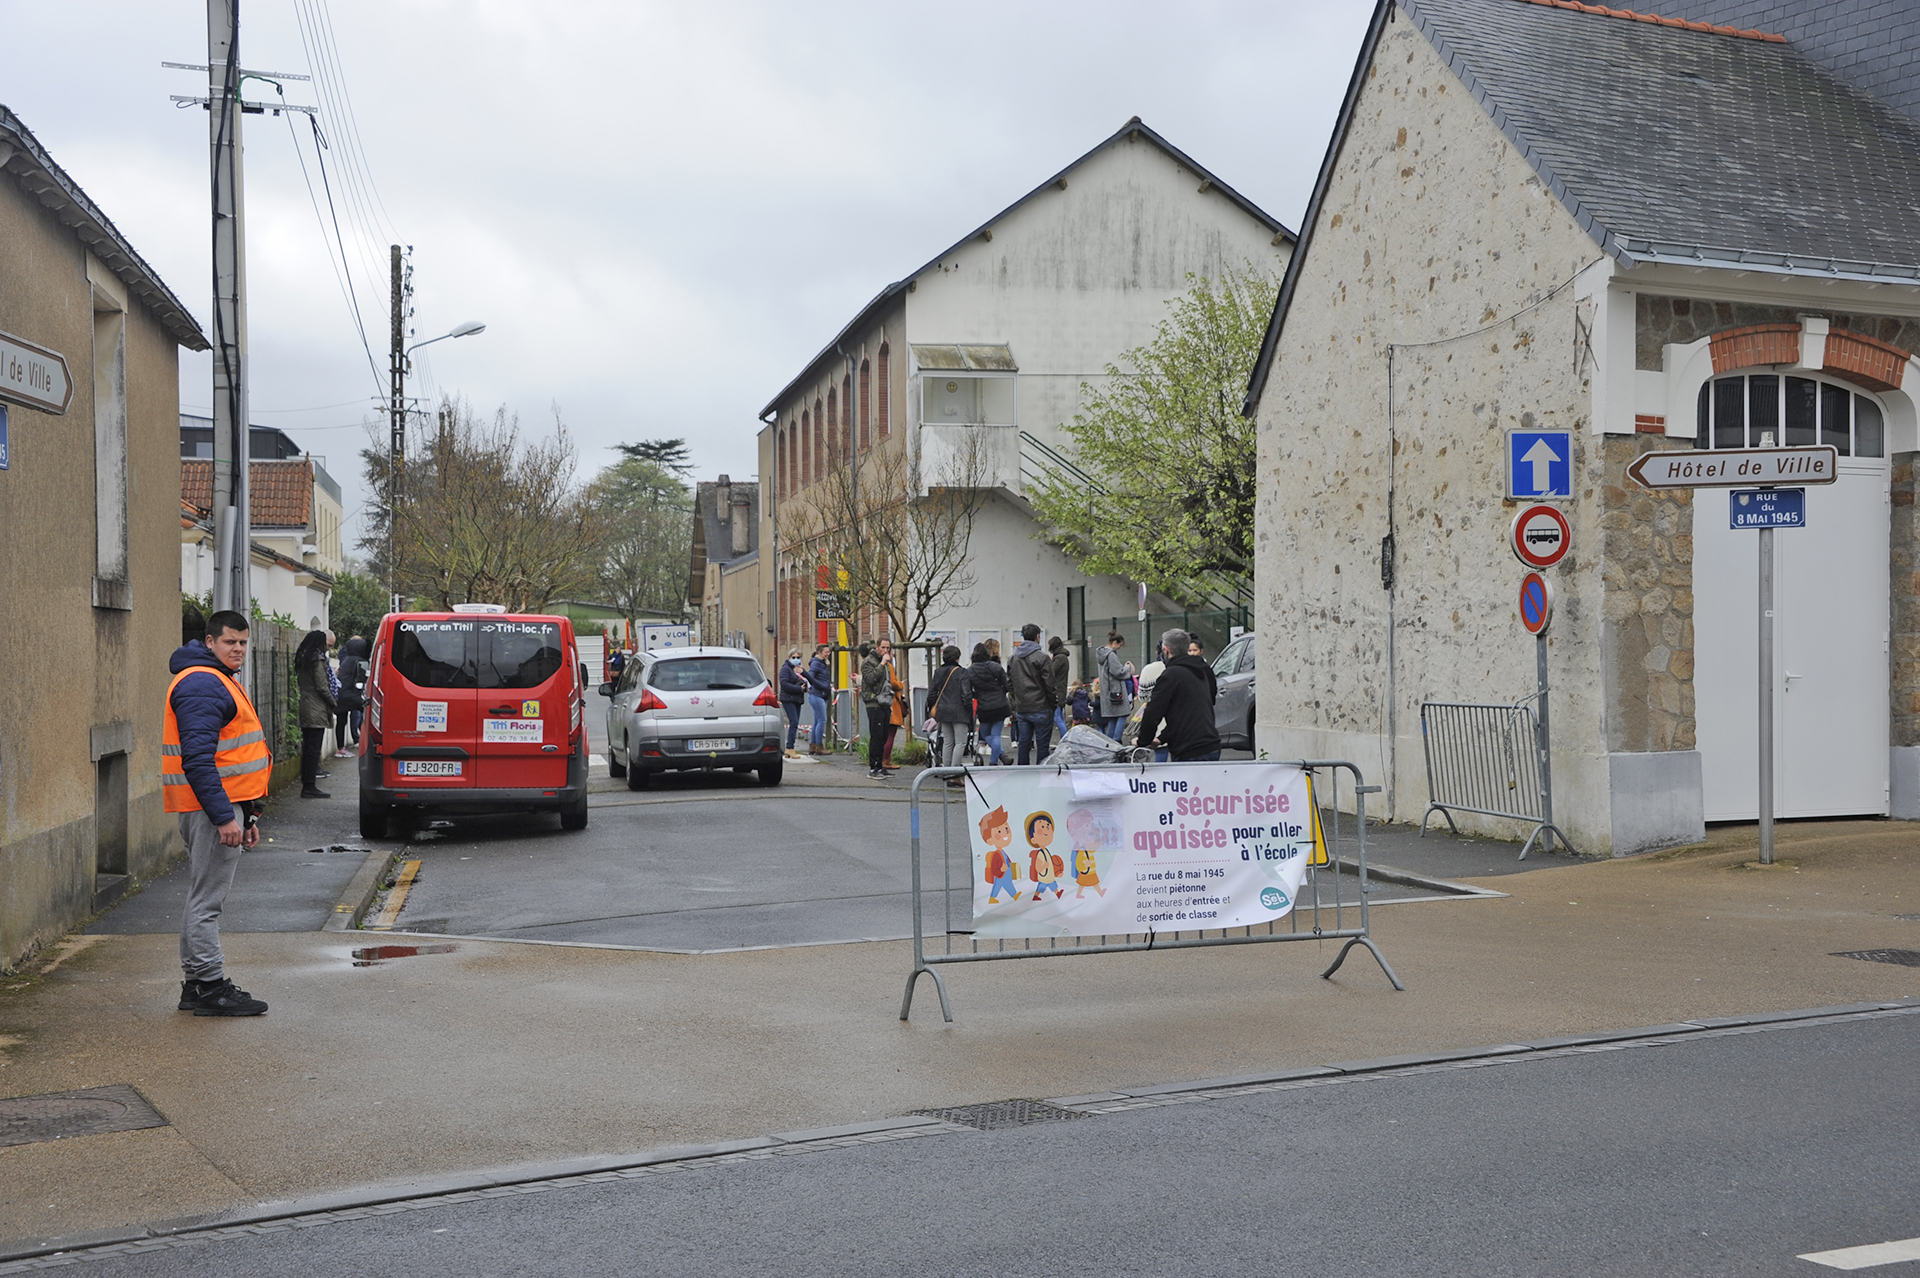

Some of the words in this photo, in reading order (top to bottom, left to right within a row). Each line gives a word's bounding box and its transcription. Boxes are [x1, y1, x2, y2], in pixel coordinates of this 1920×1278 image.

[10, 355, 22, 382] de
[28, 360, 51, 392] Ville
[1668, 460, 1726, 478] Hôtel
[1738, 459, 1762, 476] de
[1776, 456, 1824, 474] Ville
[1737, 514, 1744, 525] 8
[1771, 512, 1798, 524] 1945
[400, 623, 414, 632] On
[416, 623, 438, 633] part
[452, 622, 473, 632] Titi!
[495, 623, 553, 634] Titi-loc.fr
[491, 721, 507, 729] Titi
[510, 721, 536, 730] Floris
[406, 763, 454, 772] EJ-920-FR
[1129, 778, 1157, 794] Une
[1163, 780, 1188, 793] rue
[1176, 784, 1290, 816] sécurisée
[1159, 811, 1174, 825] et
[1133, 819, 1227, 858] apaisée
[1232, 827, 1265, 844] pour
[1271, 822, 1302, 838] aller
[1241, 844, 1250, 861] à
[1136, 872, 1146, 881] La
[1164, 871, 1175, 880] du
[1178, 871, 1183, 879] 8
[1185, 869, 1201, 878] mai
[1204, 868, 1225, 878] 1945
[1137, 885, 1167, 895] devient
[1170, 883, 1206, 895] piétonne
[1137, 900, 1152, 909] aux
[1154, 898, 1182, 908] heures
[1185, 895, 1220, 906] d'entrée
[1222, 896, 1230, 904] et
[1137, 913, 1147, 922] de
[1149, 911, 1174, 921] sortie
[1176, 910, 1187, 920] de
[1189, 909, 1217, 919] classe
